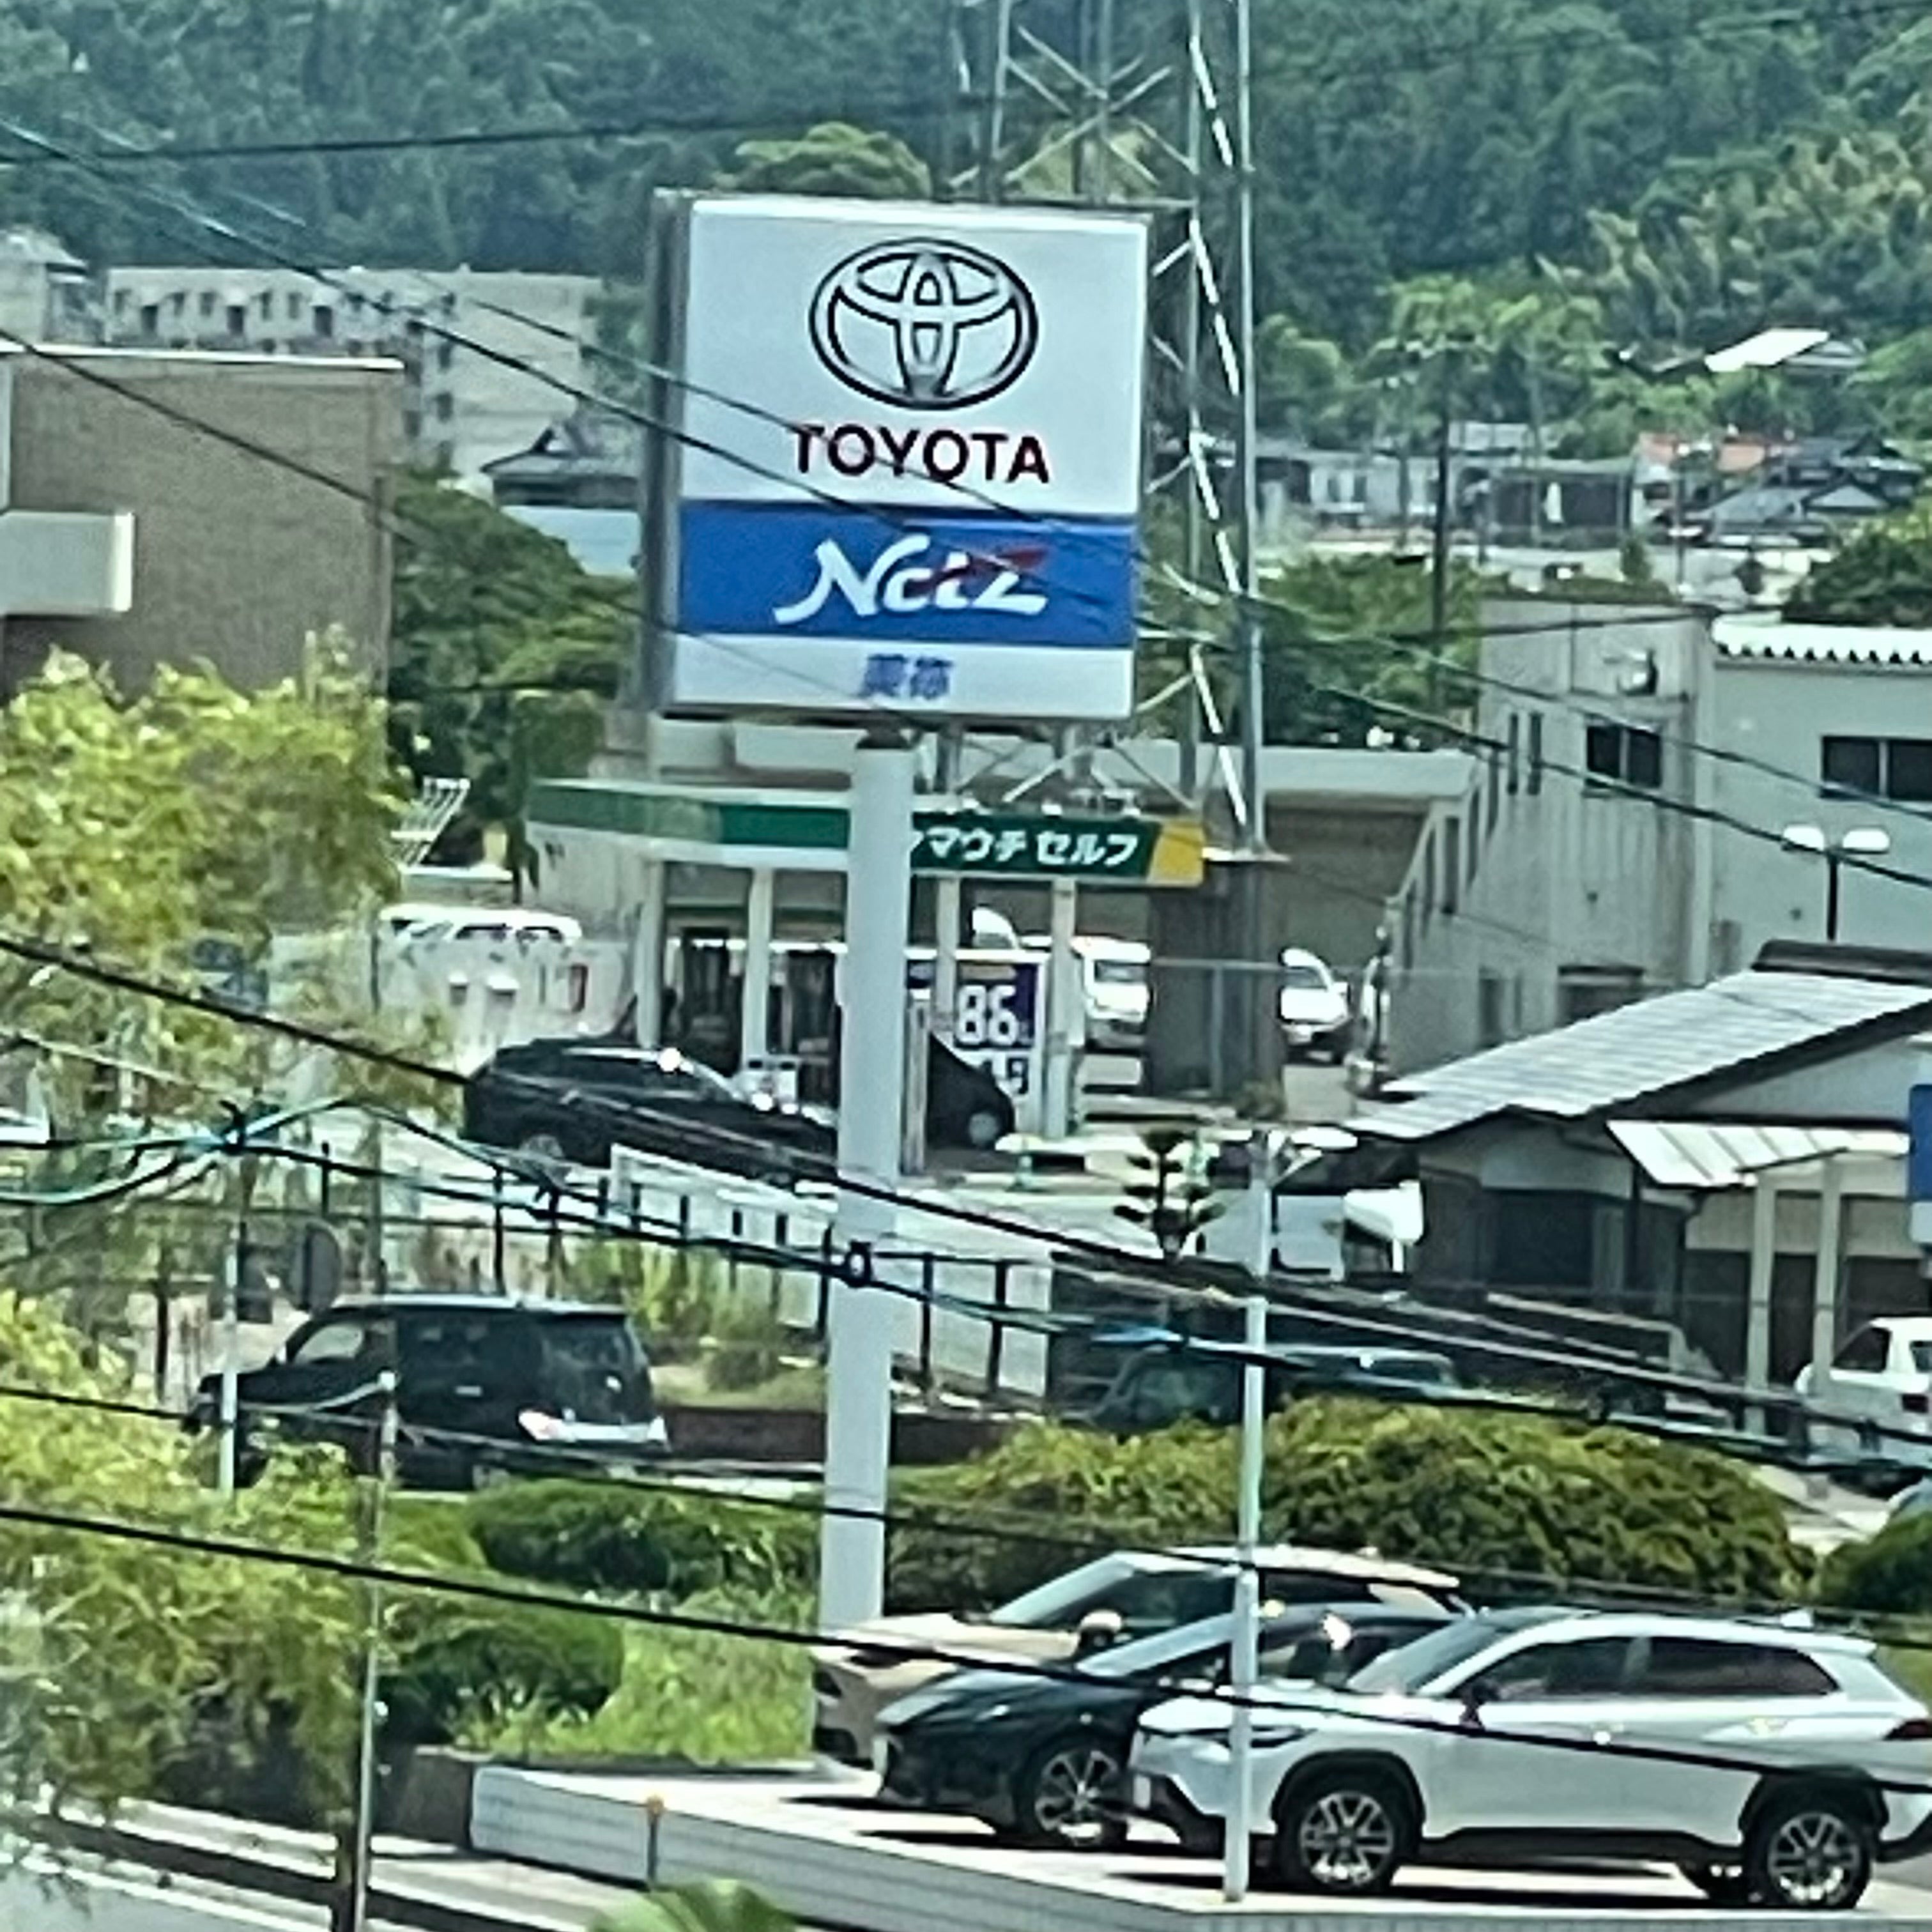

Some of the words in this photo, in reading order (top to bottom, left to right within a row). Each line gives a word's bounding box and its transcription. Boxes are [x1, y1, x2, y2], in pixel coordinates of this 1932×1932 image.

[789, 424, 1050, 483] TOYOTA
[910, 826, 1027, 862] マウチ
[1036, 831, 1138, 866] セルフ
